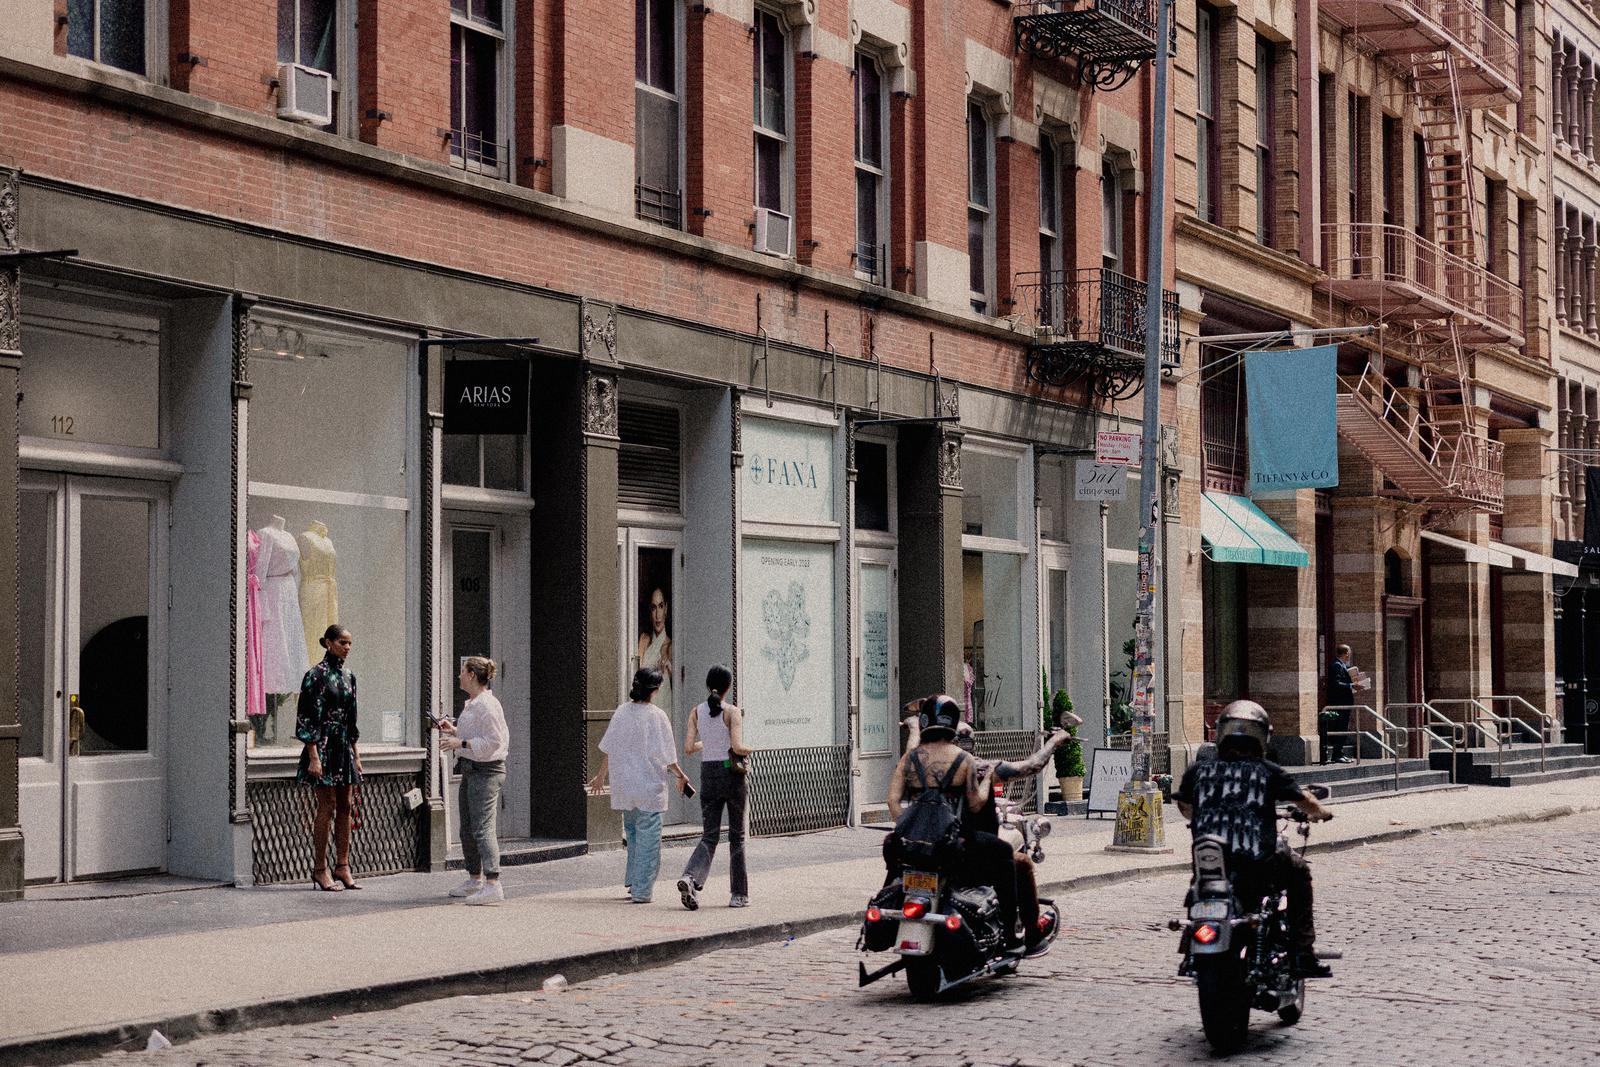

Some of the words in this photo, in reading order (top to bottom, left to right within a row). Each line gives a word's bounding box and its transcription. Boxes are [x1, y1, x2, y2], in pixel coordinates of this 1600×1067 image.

[460, 386, 511, 403] ARIAS
[51, 415, 74, 435] 112
[768, 459, 817, 488] FANA
[1079, 487, 1097, 497] cinq
[1104, 487, 1120, 497] sept
[1584, 546, 1600, 554] SAL
[761, 556, 783, 567] OPENING
[784, 558, 798, 567] EARLY
[460, 577, 480, 593] 108
[1102, 765, 1128, 776] NEW
